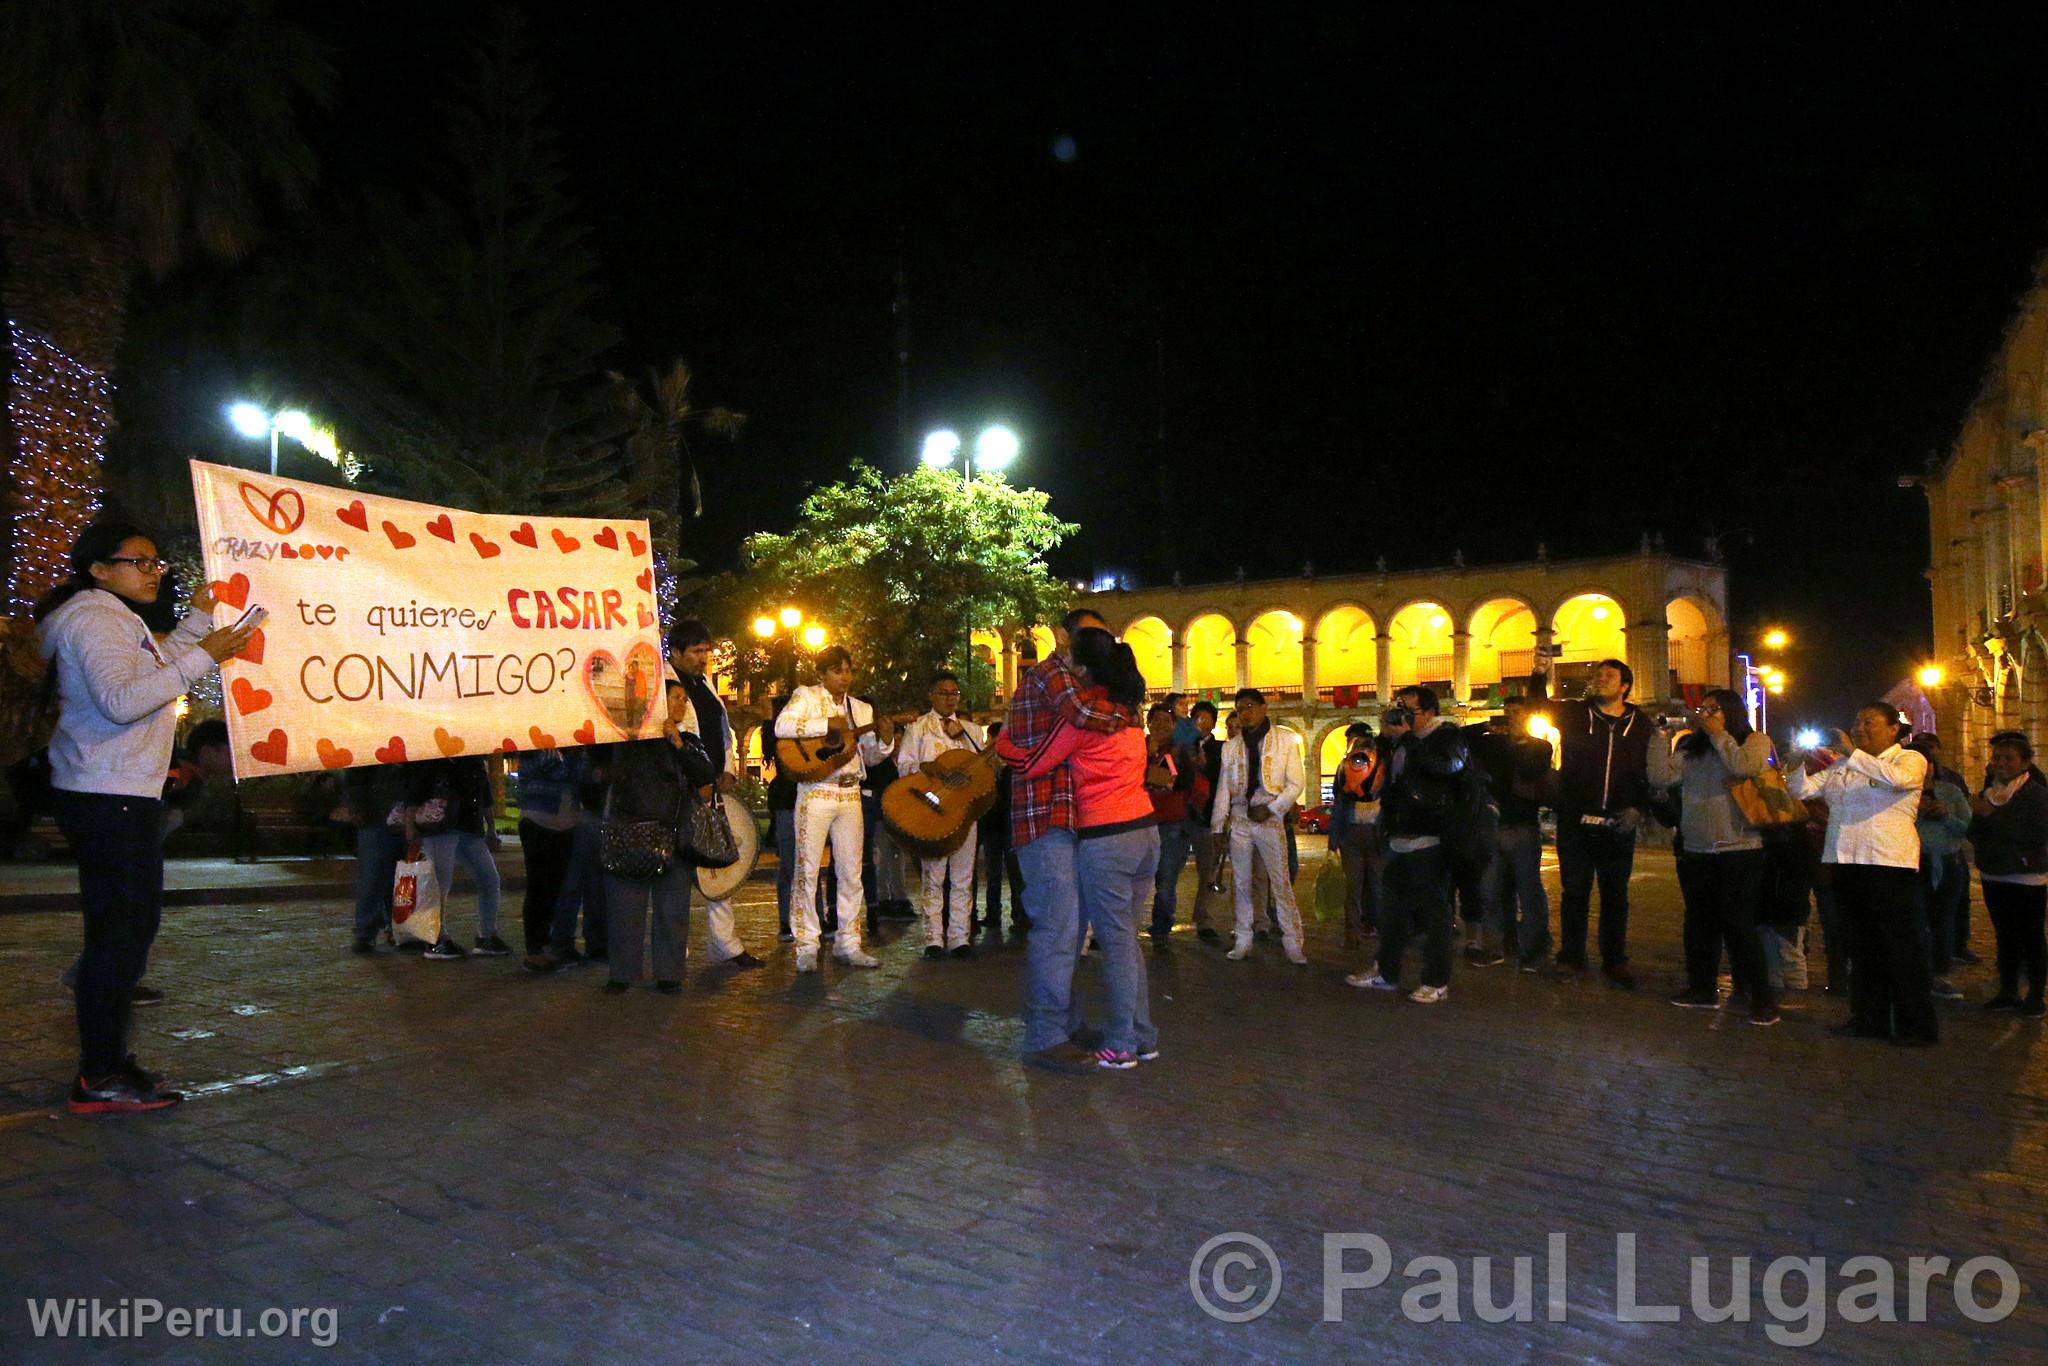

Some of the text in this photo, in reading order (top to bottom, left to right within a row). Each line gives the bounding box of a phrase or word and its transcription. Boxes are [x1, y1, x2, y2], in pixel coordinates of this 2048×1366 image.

[213, 537, 279, 561] CRAZY
[297, 587, 628, 636] te quieres CASAR
[300, 647, 576, 703] CONMIGO?
